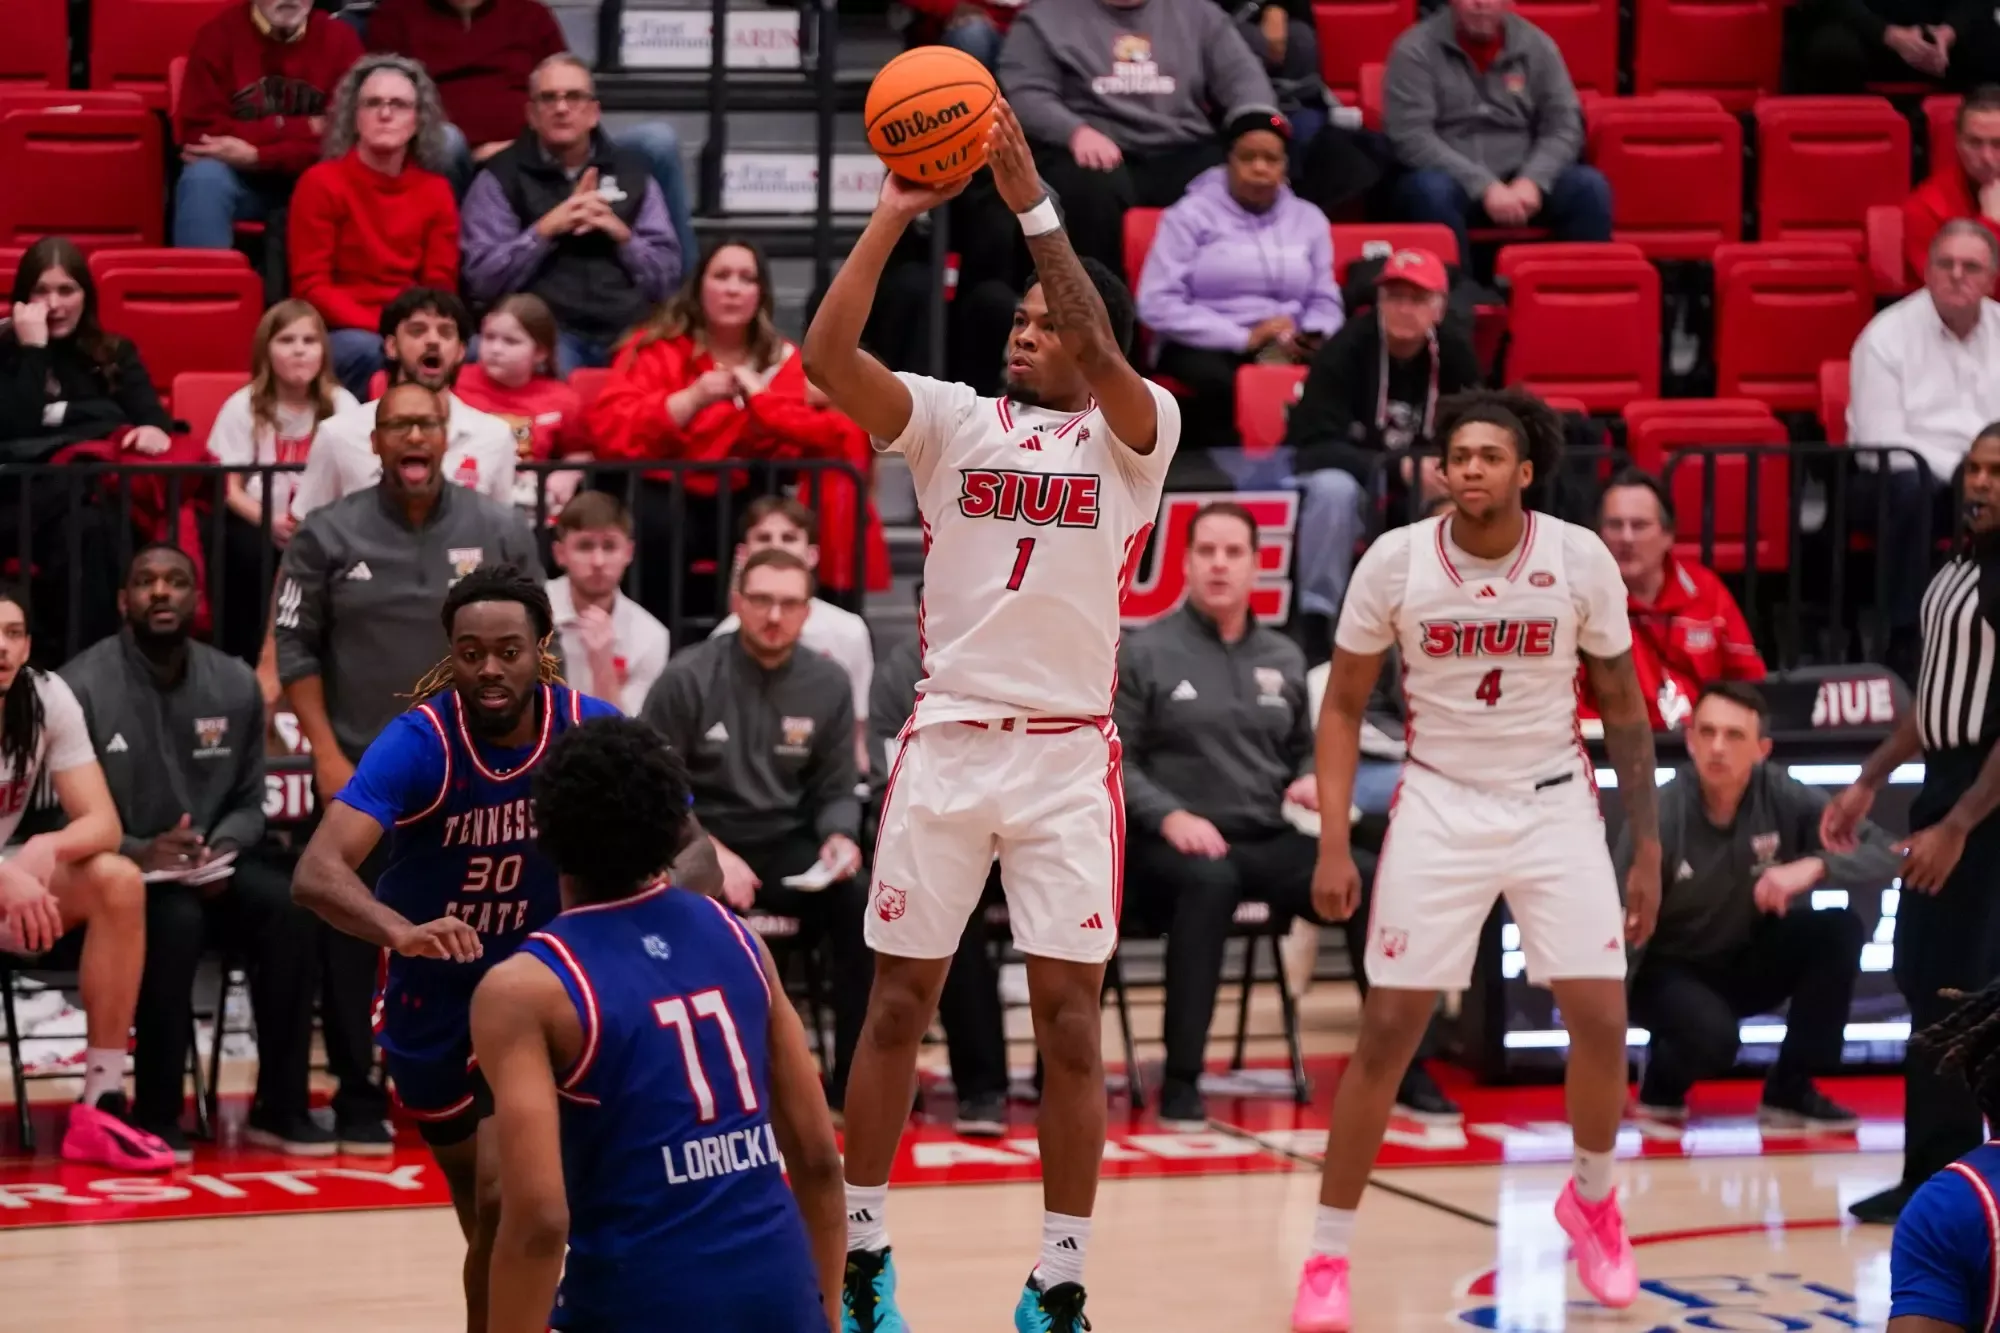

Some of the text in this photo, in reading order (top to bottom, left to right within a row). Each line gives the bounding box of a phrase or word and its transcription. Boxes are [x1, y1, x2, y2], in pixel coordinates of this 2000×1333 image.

[880, 100, 970, 146] Wilson
[957, 468, 1101, 529] SIUE
[1006, 537, 1036, 591] 1
[1420, 617, 1557, 658] SIUE
[1476, 667, 1504, 706] 4
[461, 854, 523, 894] 30
